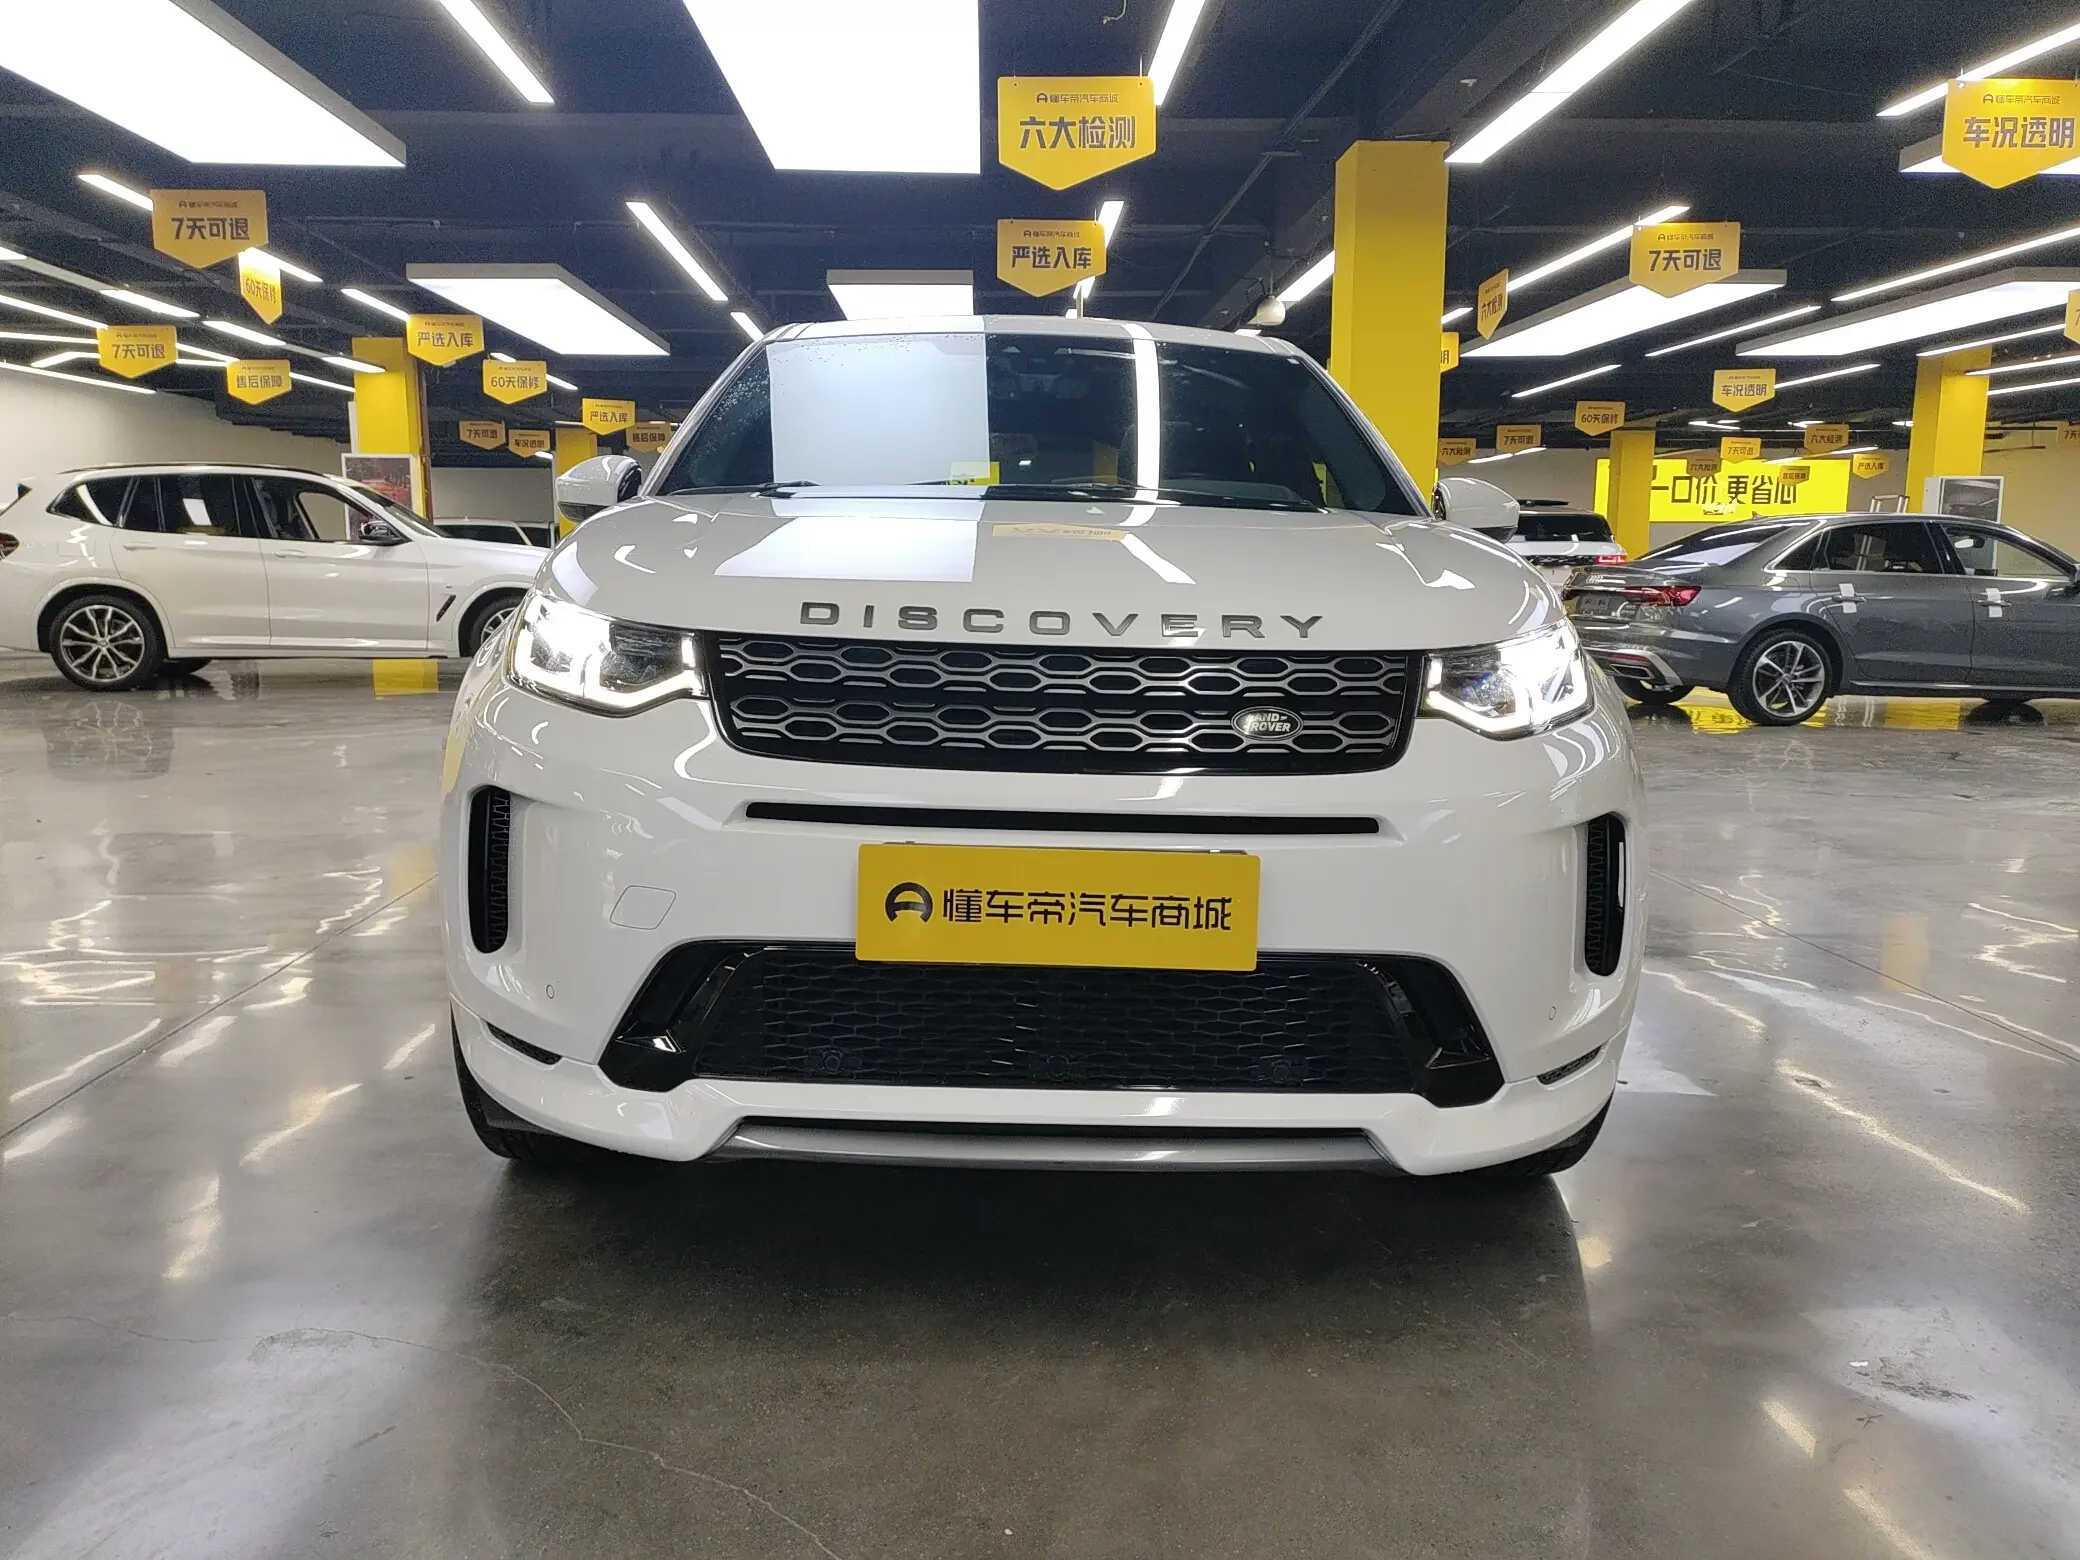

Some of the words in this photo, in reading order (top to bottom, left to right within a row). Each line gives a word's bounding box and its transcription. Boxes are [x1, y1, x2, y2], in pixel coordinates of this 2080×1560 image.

[1020, 116, 1136, 149] 六大检测
[1963, 116, 2075, 148] 车况透明
[171, 217, 250, 240] 7天可退
[1011, 246, 1092, 269] 严选入库
[1649, 248, 1722, 271] 7天可退
[246, 278, 276, 304] 60天保修
[417, 331, 474, 347] 严选入库
[112, 343, 166, 359] 7天可退
[236, 374, 283, 389] 售后保障
[490, 376, 540, 390] 60天保修
[1721, 384, 1767, 396] 车况透明
[589, 411, 628, 423] 严选入库
[1580, 413, 1620, 425] 60天保修
[466, 429, 499, 439] 7天可退
[1503, 434, 1534, 445] 7天可退
[1651, 475, 1717, 505] 一口价
[1727, 474, 1798, 505] 更省心
[800, 602, 1323, 639] DISCOVERY
[1249, 722, 1291, 732] ROVER
[943, 888, 1233, 931] 懂车帝汽车商城
